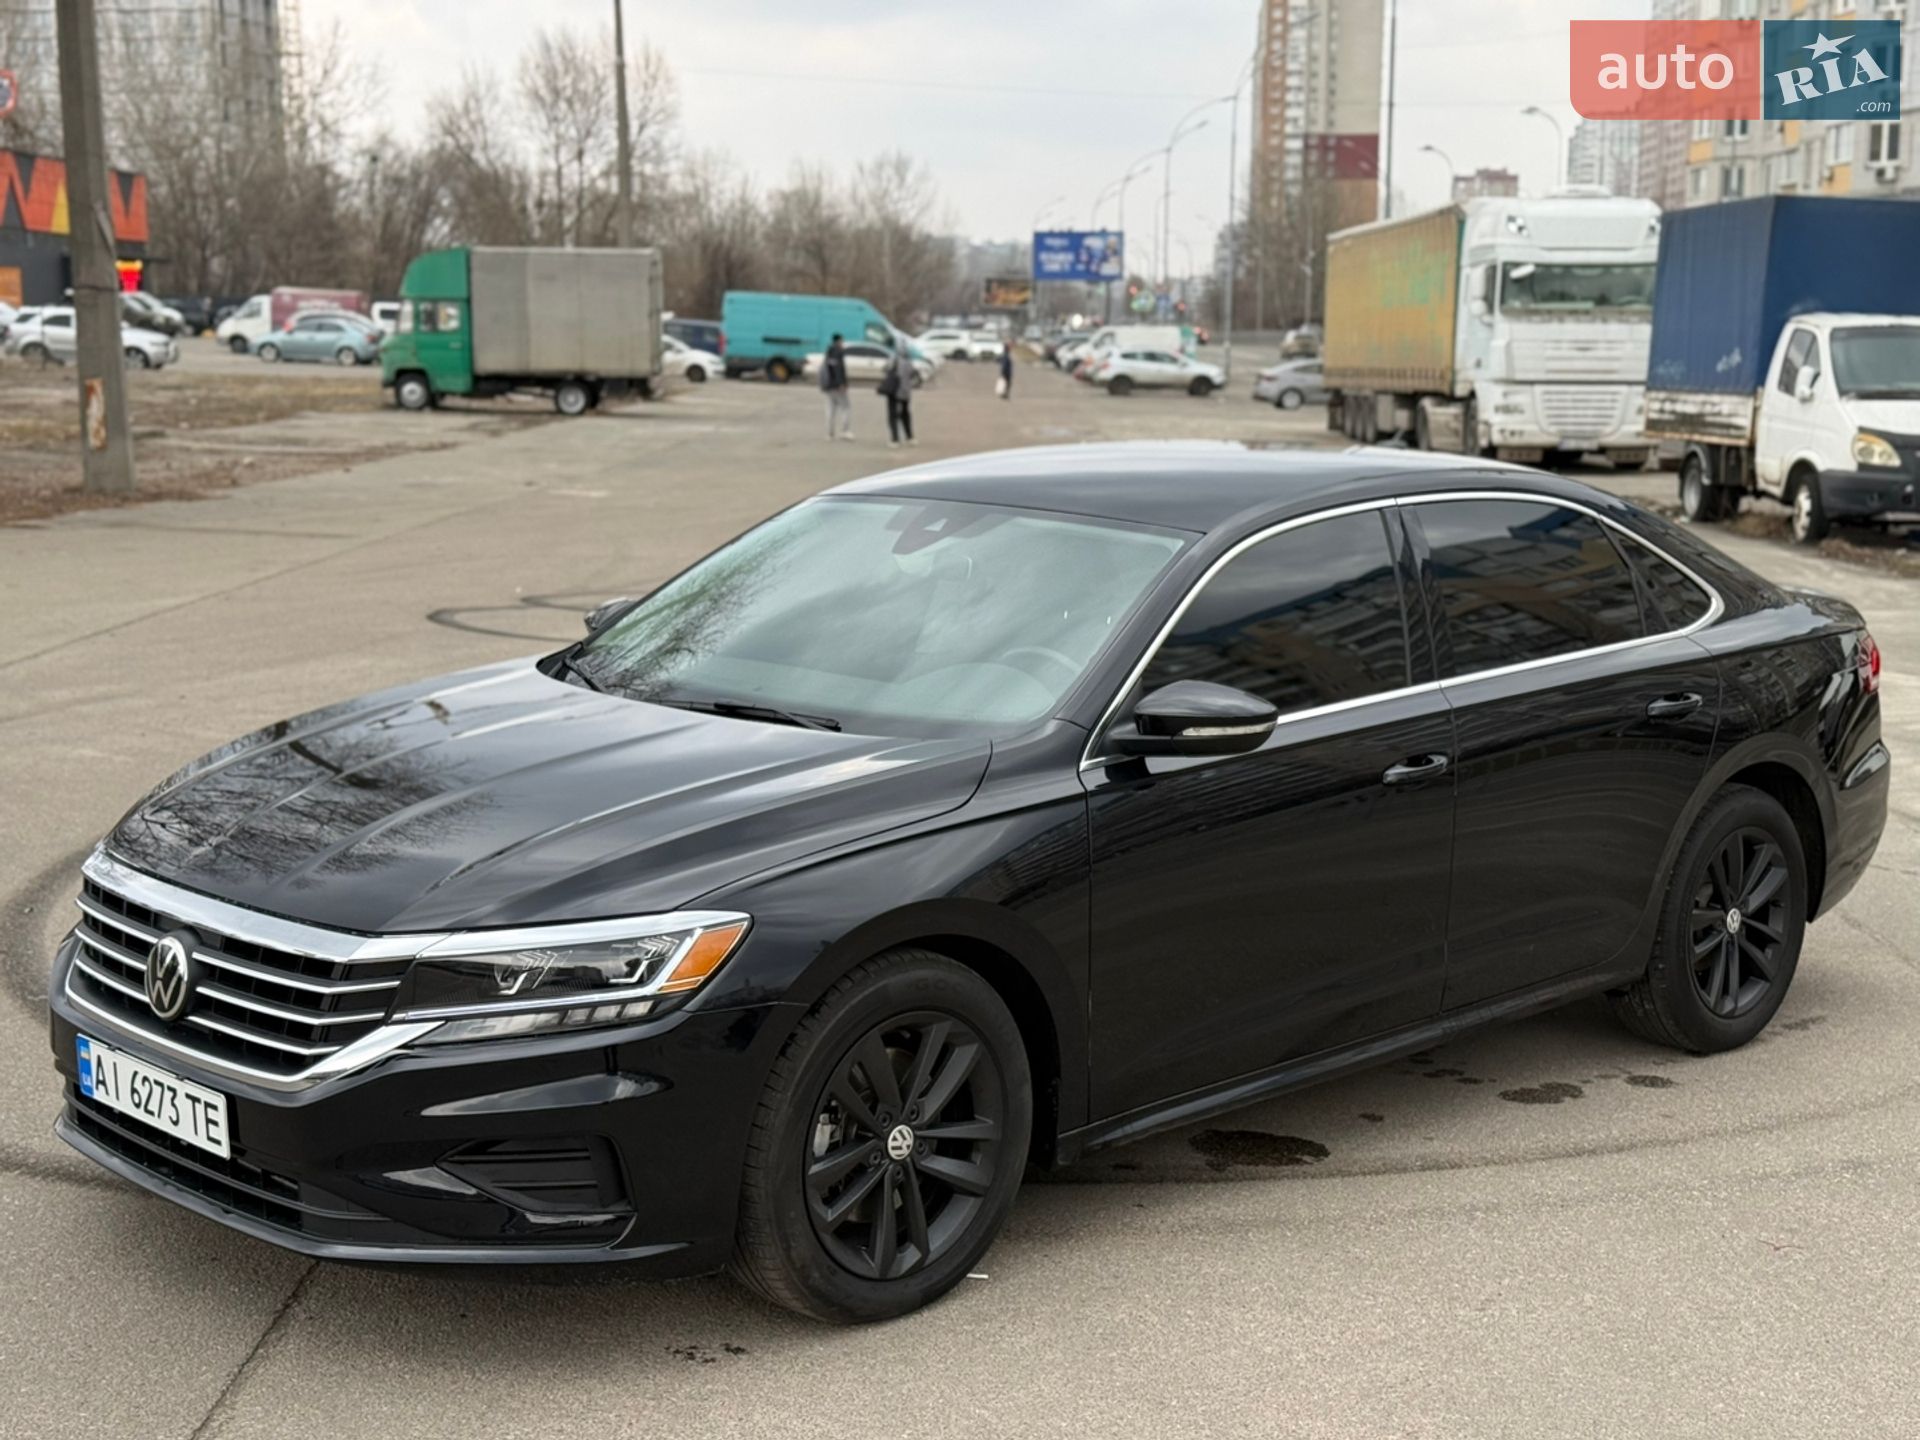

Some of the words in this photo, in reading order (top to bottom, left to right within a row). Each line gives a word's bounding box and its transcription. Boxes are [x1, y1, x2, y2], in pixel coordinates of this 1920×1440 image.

[95, 1054, 120, 1101] AI
[130, 1070, 180, 1127] 6273
[185, 1092, 222, 1147] TE
